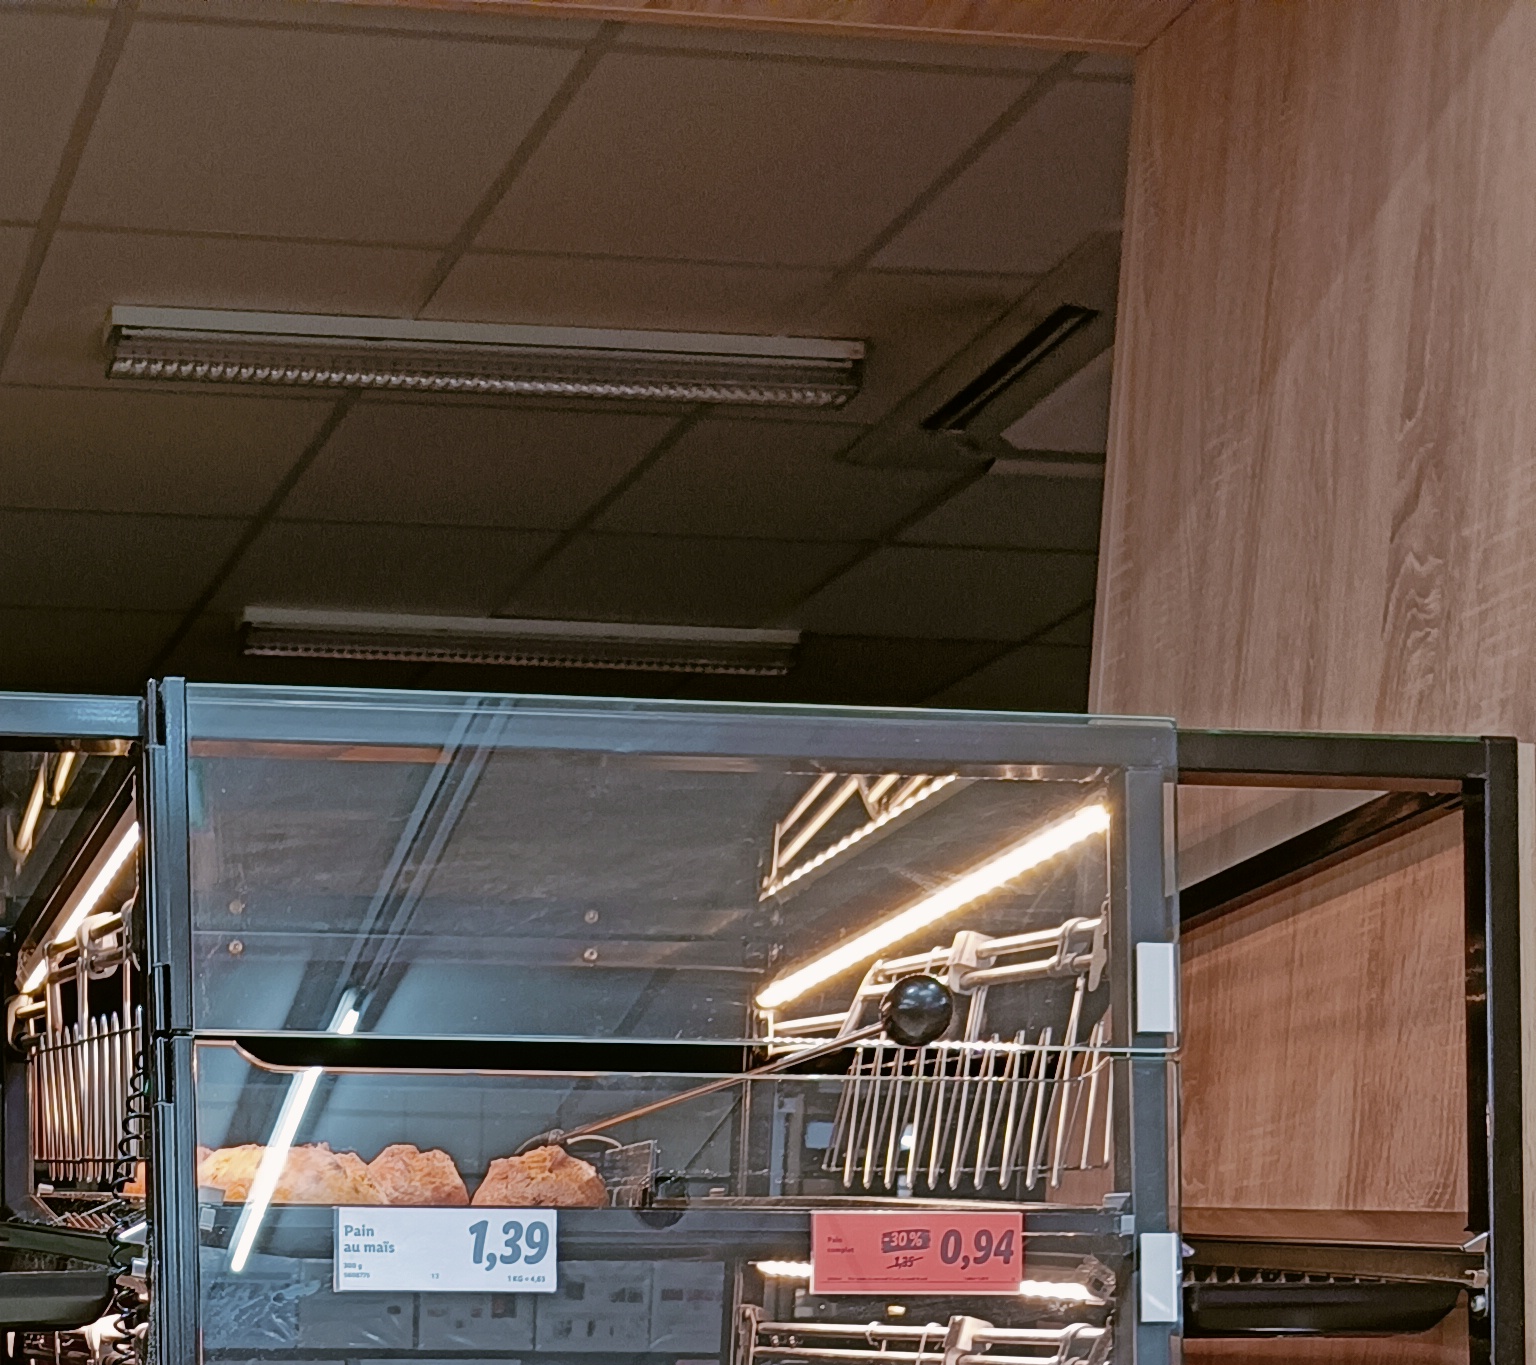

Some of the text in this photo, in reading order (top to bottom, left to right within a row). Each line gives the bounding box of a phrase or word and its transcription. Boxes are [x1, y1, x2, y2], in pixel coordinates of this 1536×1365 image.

[344, 1224, 375, 1237] Pain
[343, 1241, 395, 1253] au maïs
[468, 1220, 550, 1272] 1,39
[940, 1228, 1014, 1270] 0,94
